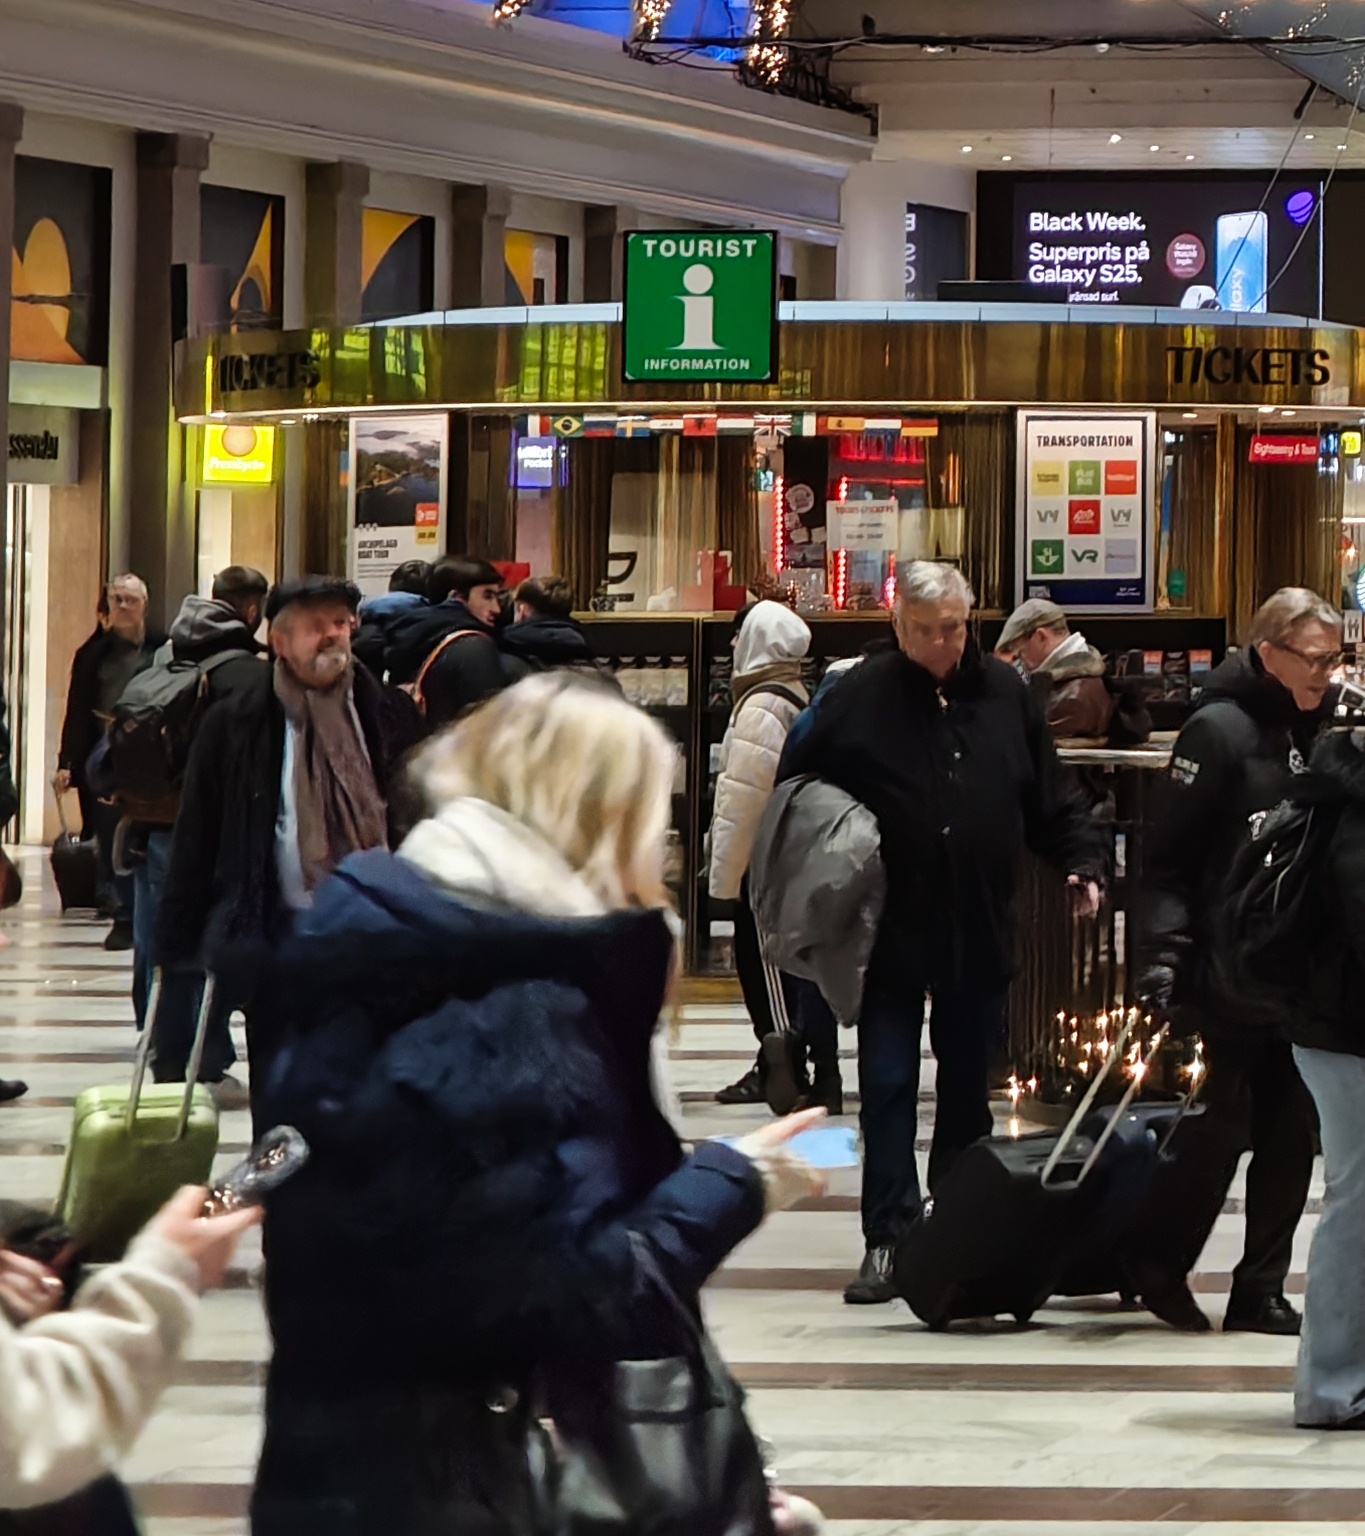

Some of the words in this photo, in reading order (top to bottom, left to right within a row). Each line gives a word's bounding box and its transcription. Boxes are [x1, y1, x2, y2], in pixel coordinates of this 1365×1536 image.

[1029, 212, 1083, 231] Black
[1086, 212, 1146, 231] Week.
[643, 239, 757, 258] TOURIST
[1029, 243, 1122, 264] Superpris
[1125, 241, 1150, 265] på
[1029, 265, 1094, 287] Galaxy
[1100, 265, 1142, 283] S25.
[644, 358, 750, 371] INFORMATION
[1166, 346, 1331, 386] TICKETS
[1036, 435, 1134, 448] TRANSPORTATION
[1071, 549, 1098, 563] VR
